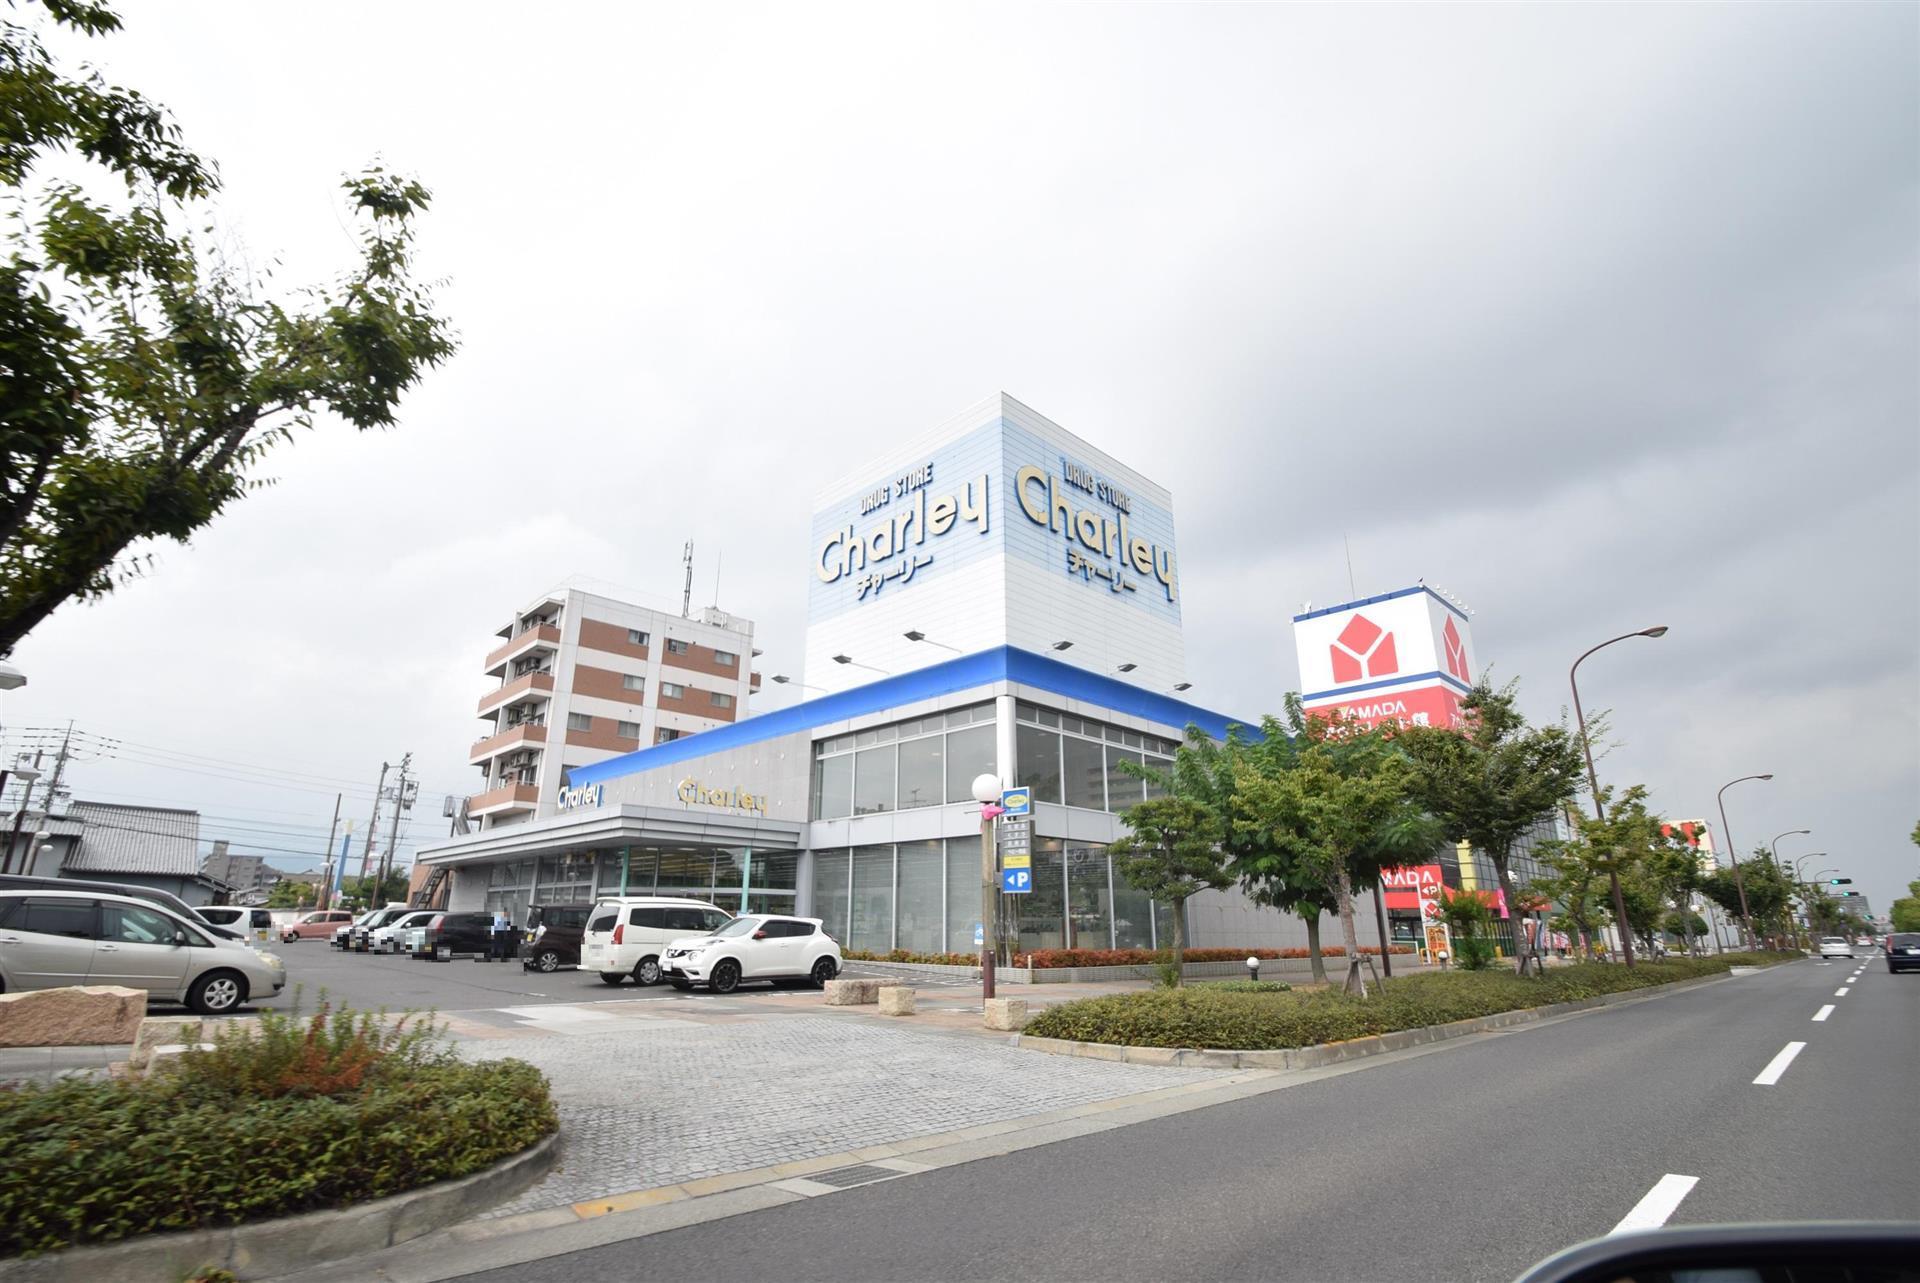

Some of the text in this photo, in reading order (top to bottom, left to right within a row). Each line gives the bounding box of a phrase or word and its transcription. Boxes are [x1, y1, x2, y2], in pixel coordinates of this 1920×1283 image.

[861, 461, 934, 516] DRUG STORE
[1062, 460, 1131, 515] DRUG STORE
[817, 474, 989, 583] Charley
[1014, 464, 1177, 603] Charley
[857, 555, 934, 601] チャーリー
[1066, 547, 1137, 594] チャーリー
[1338, 700, 1407, 720] YAMADA
[557, 780, 604, 810] Charley
[677, 776, 768, 817] Charley
[1017, 871, 1029, 888] P
